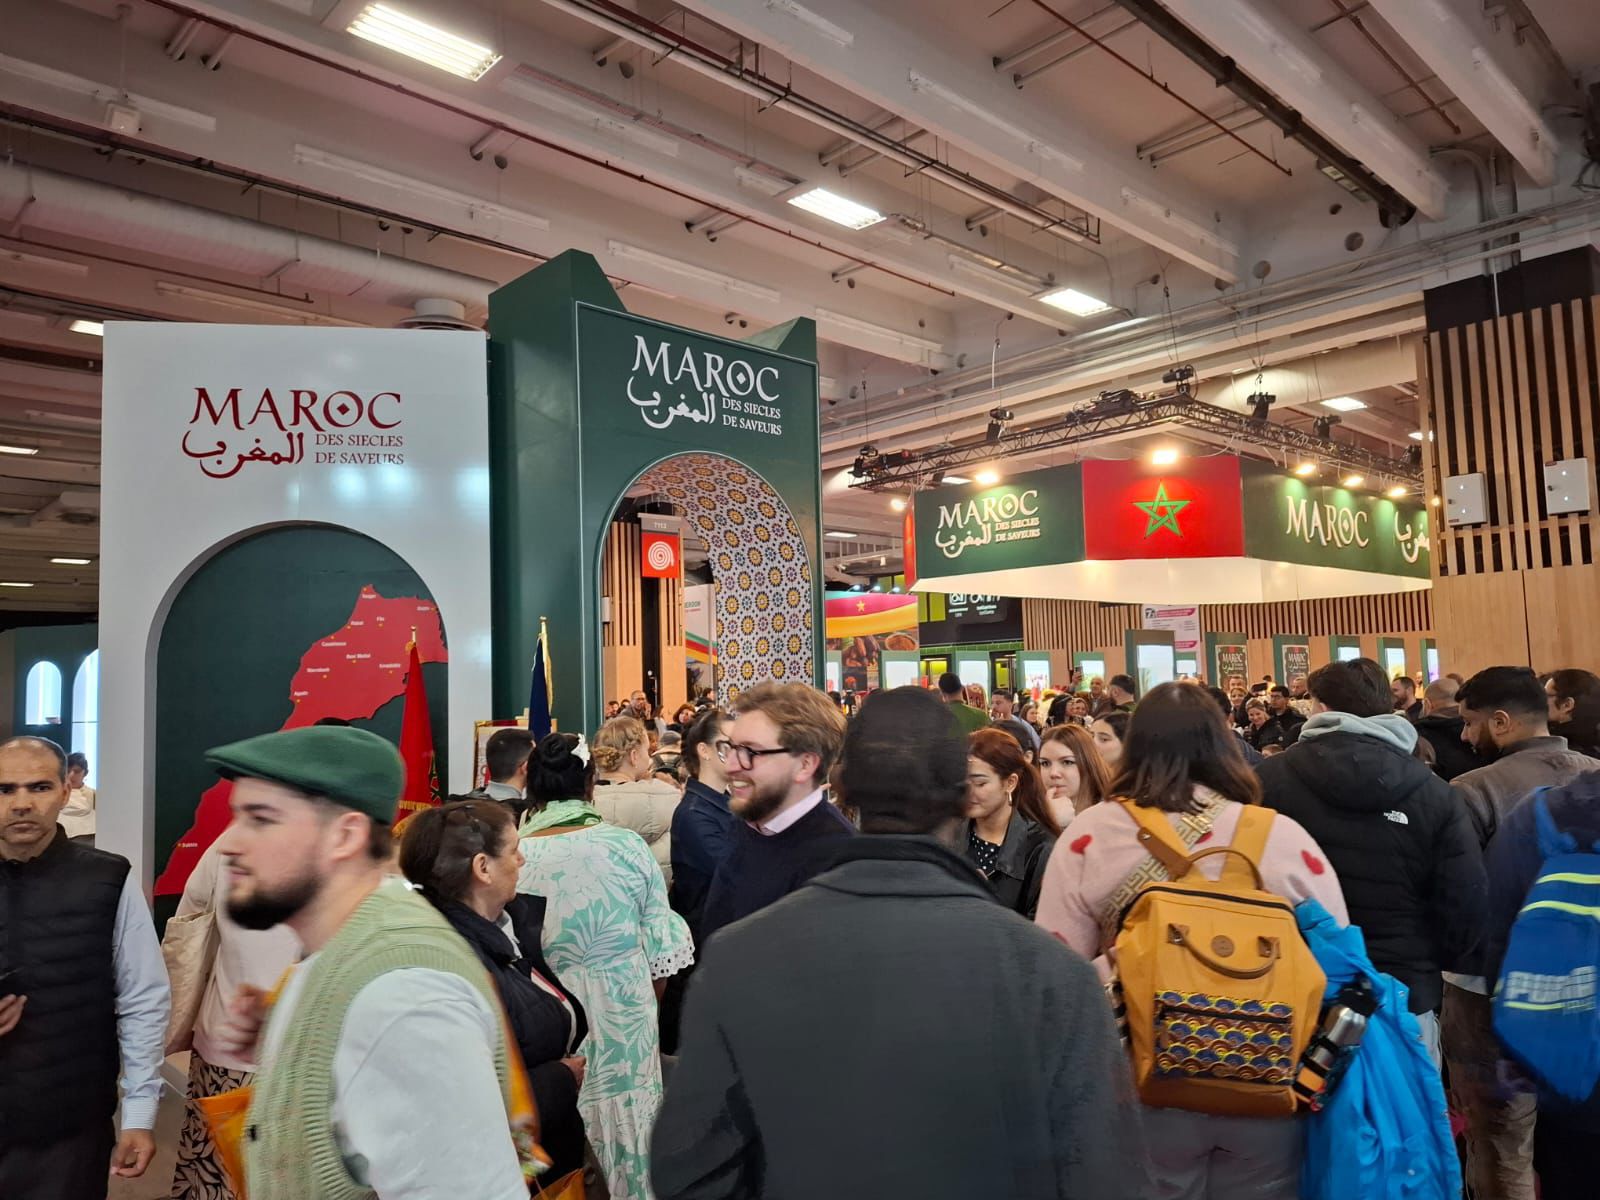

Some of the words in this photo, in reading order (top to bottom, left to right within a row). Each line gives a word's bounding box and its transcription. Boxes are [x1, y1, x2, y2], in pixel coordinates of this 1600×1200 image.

[631, 335, 780, 402] MAROC
[189, 387, 402, 432] MAROC
[626, 375, 716, 430] المغرب
[722, 397, 742, 411] DES
[744, 400, 781, 419] SIECLES
[315, 433, 344, 446] DES
[347, 434, 404, 448] SIECLES
[722, 414, 738, 427] DE
[739, 418, 782, 436] SAVEURS
[181, 430, 304, 479] المغرب
[315, 451, 337, 464] DE
[339, 452, 405, 465] SAVEURS
[938, 490, 1038, 529] MAROC
[995, 521, 1010, 531] DES
[1286, 495, 1369, 548] MAROC
[935, 523, 992, 558] المغرب
[995, 533, 1006, 542] DE
